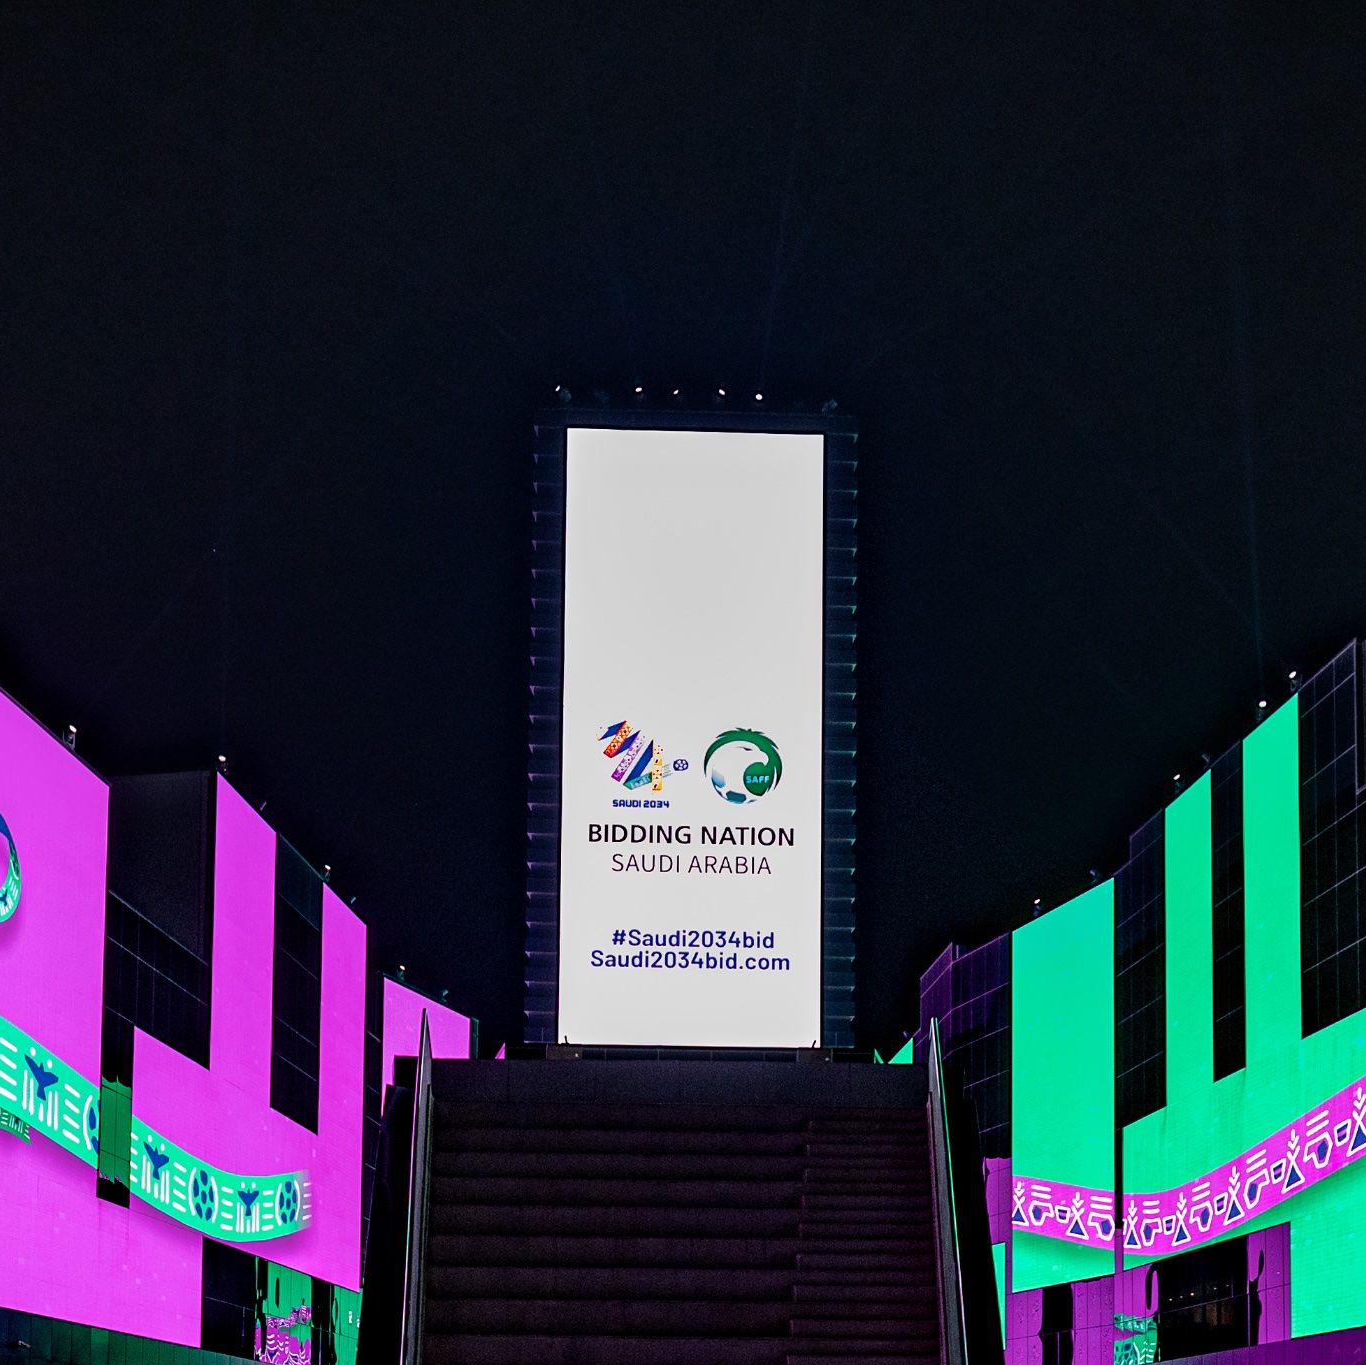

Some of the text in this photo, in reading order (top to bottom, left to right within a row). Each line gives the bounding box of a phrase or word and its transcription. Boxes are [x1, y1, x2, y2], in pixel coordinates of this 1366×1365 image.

[745, 775, 770, 784] SAFF
[612, 799, 670, 809] SAUDI 2034
[588, 823, 795, 847] BIDDING NATION
[611, 853, 772, 875] SAUDI ARABIA
[611, 928, 775, 949] #Saudi2034bid
[590, 949, 791, 971] Saudi2034bid.com
